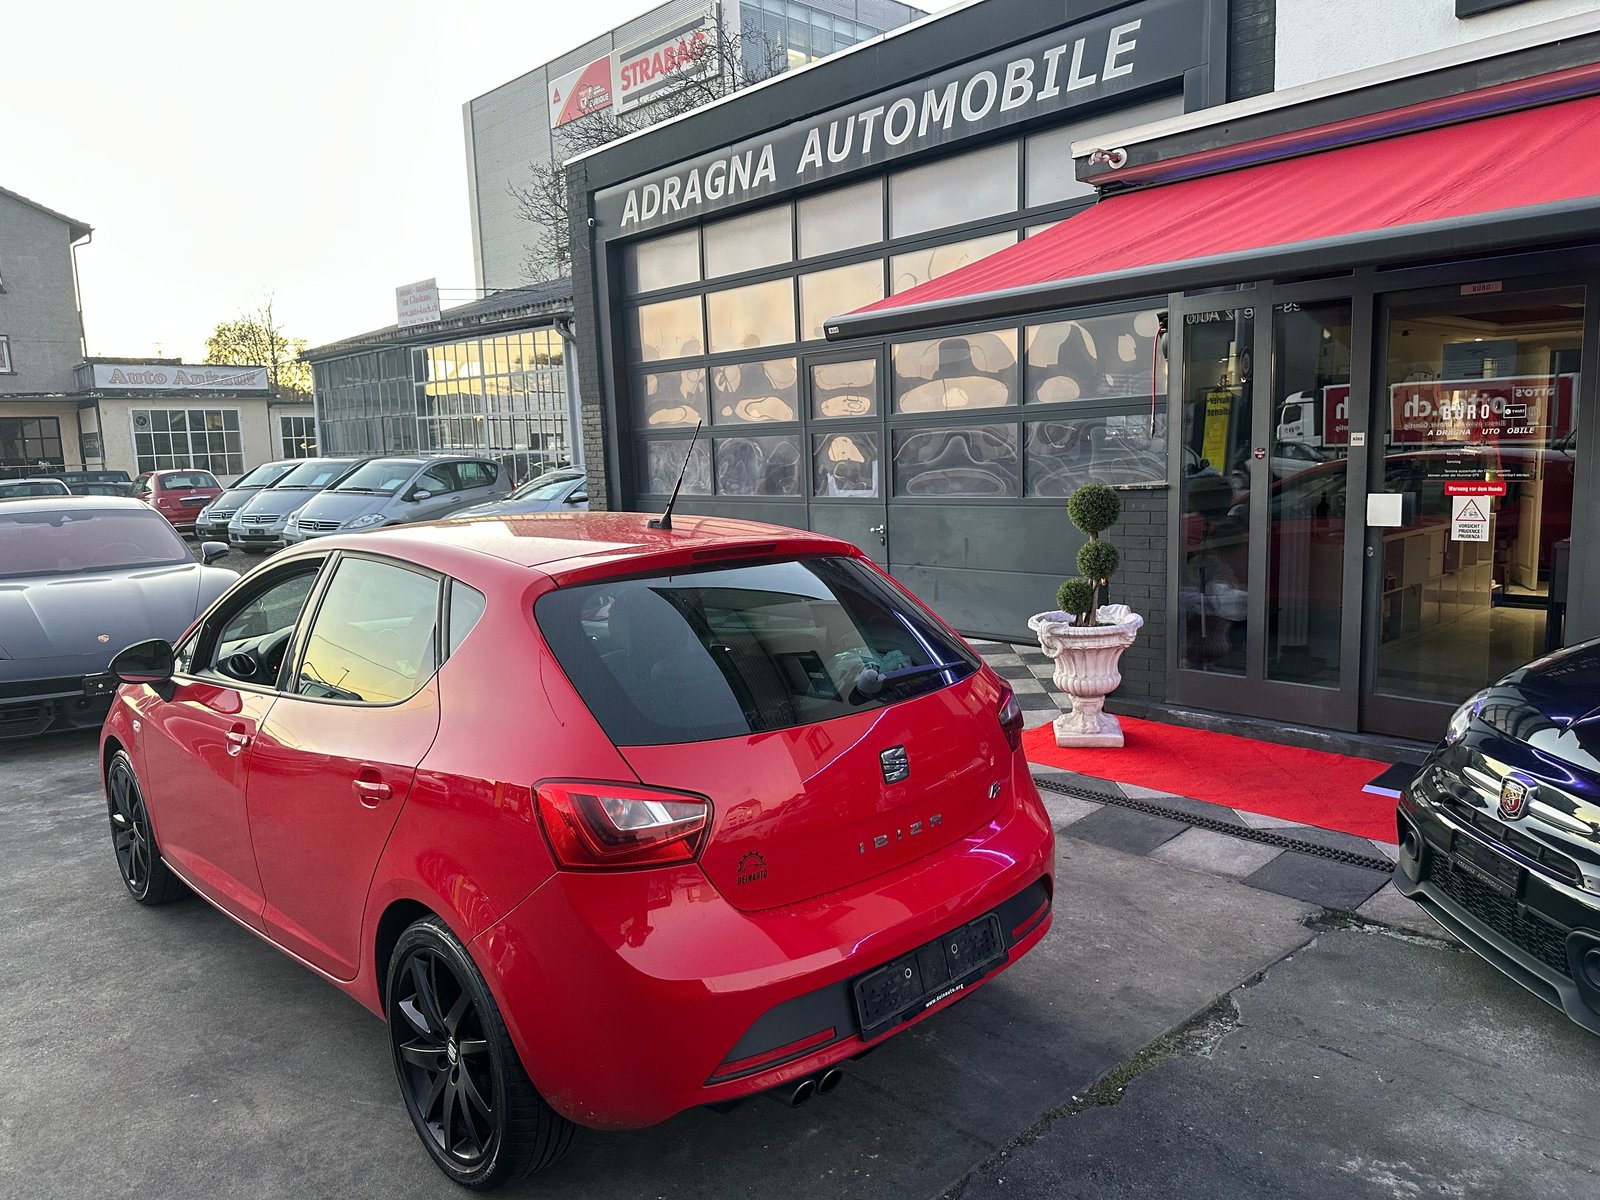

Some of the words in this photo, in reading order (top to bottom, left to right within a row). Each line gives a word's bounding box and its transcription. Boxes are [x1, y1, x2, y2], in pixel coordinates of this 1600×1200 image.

[620, 33, 706, 91] STRABAG
[621, 144, 776, 227] ADRAGNA
[797, 19, 1142, 174] AUTOMOBILE
[109, 368, 168, 385] Auto
[859, 813, 942, 855] IBIZA
